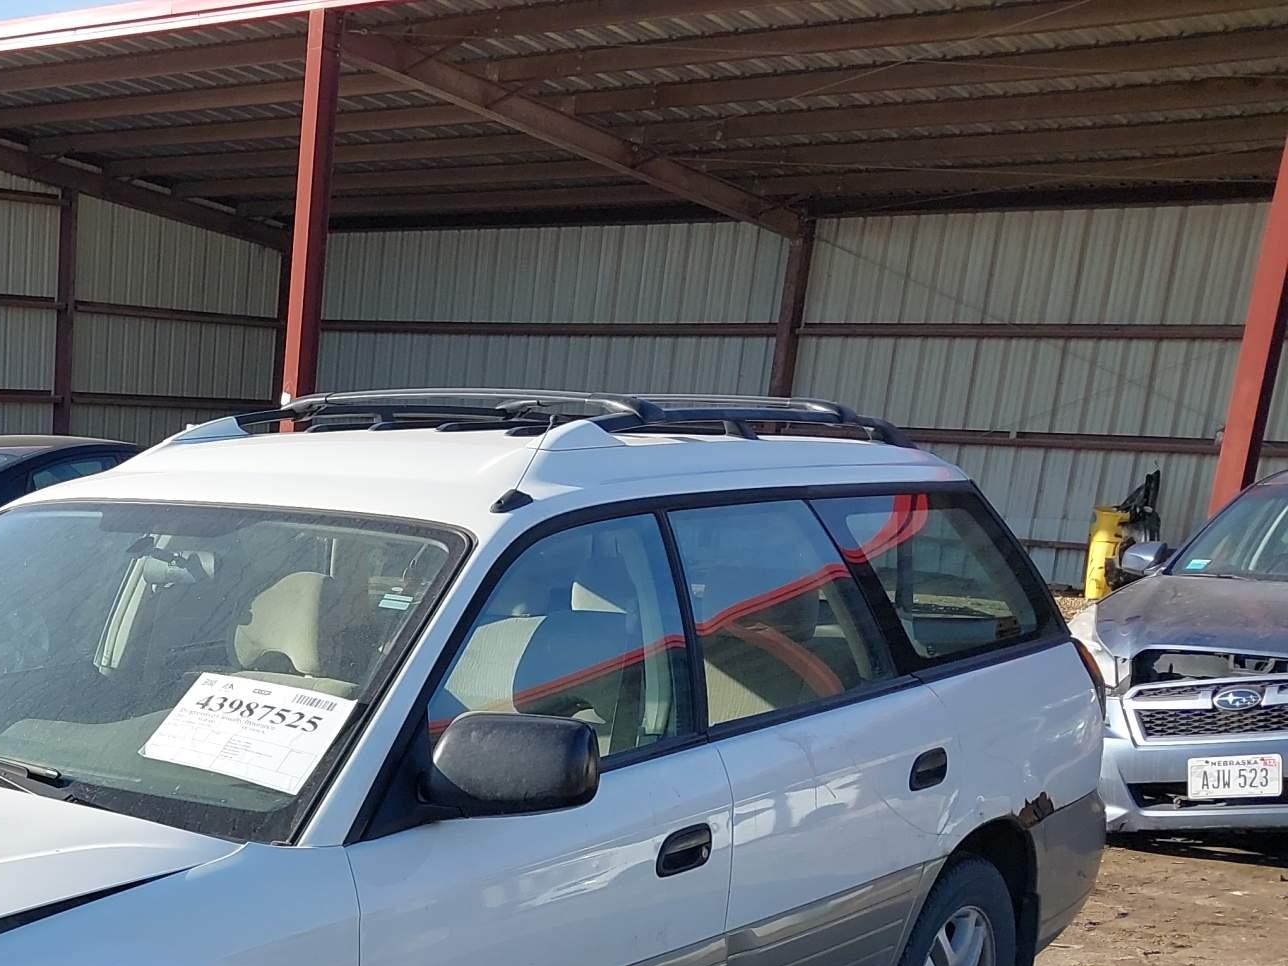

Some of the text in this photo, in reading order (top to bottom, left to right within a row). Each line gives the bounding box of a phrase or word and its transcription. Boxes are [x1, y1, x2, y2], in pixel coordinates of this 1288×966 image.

[196, 695, 324, 733] 43987525
[1210, 759, 1259, 767] NEBRASKA
[1201, 767, 1269, 790] AJW 523
